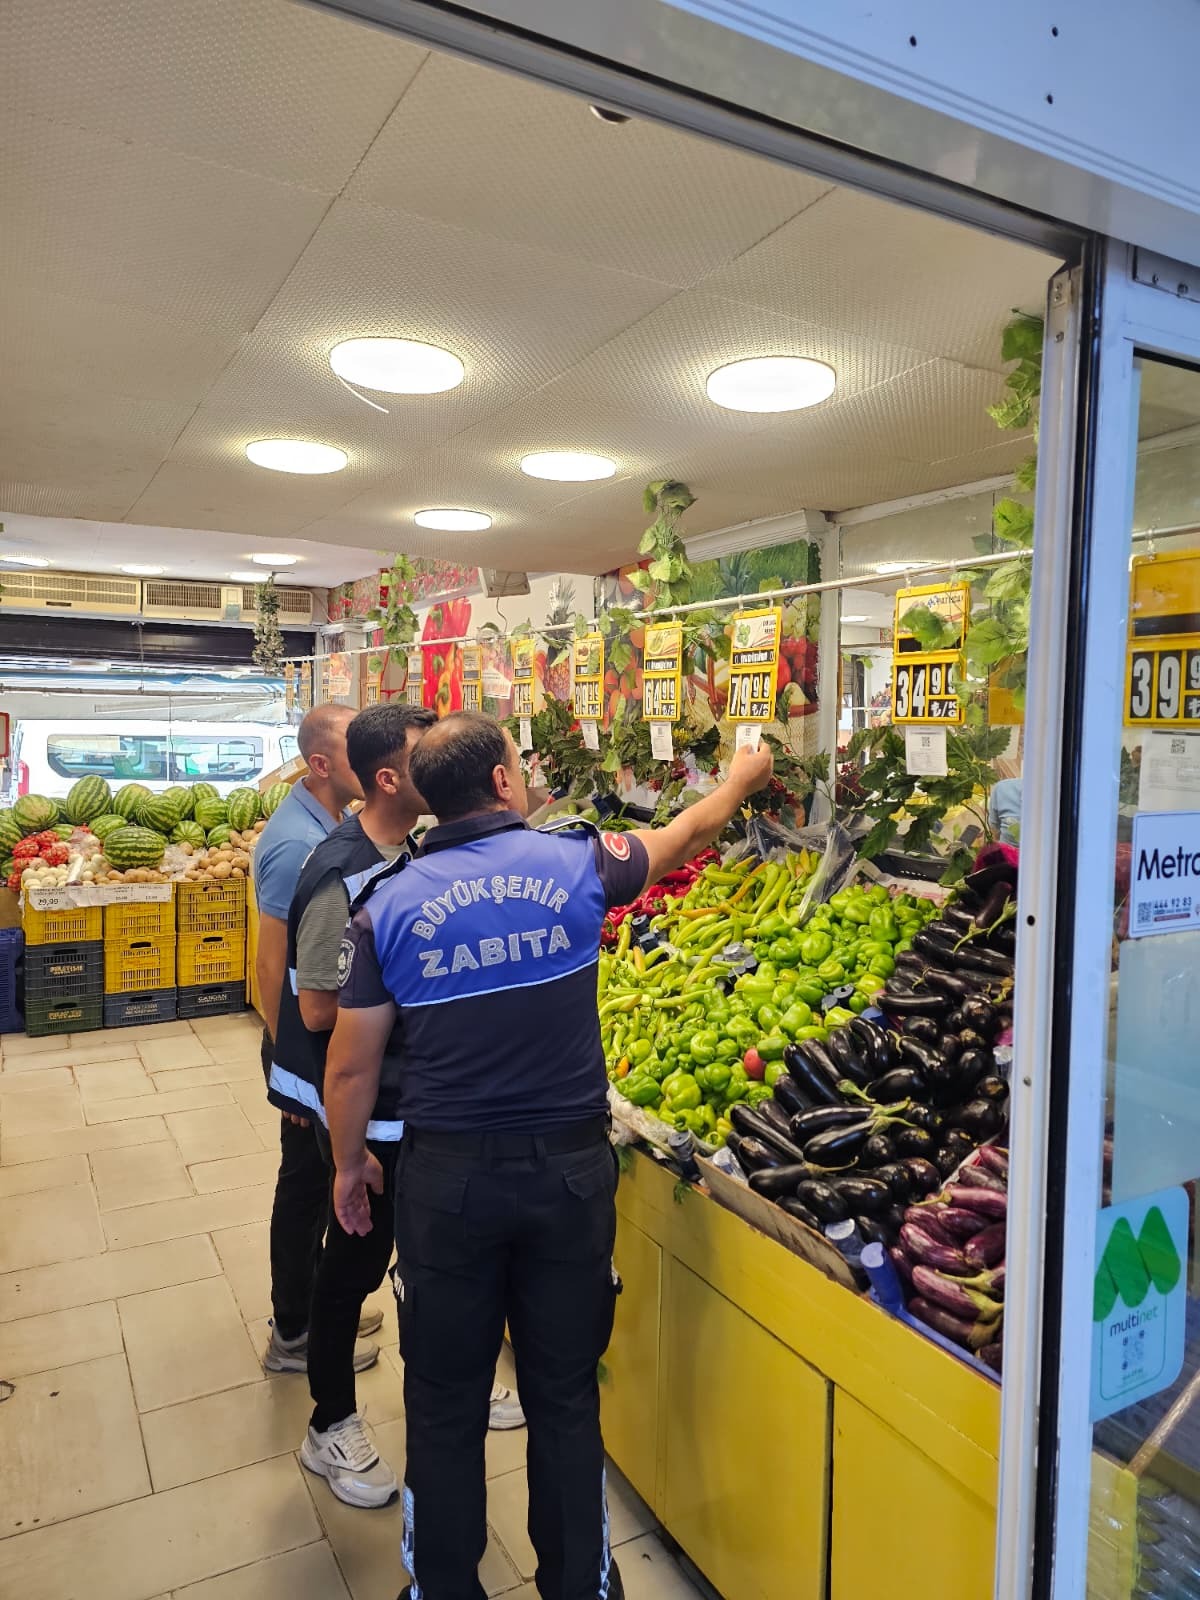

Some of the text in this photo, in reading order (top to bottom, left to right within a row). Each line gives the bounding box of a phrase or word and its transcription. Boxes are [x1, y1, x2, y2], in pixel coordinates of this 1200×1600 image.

[729, 676, 750, 716] 79
[896, 668, 926, 717] 34
[1131, 655, 1181, 719] 39
[411, 875, 569, 941] BÜYÜKŞEHİR
[418, 925, 571, 979] ZABITA
[1110, 1305, 1159, 1337] multinet
